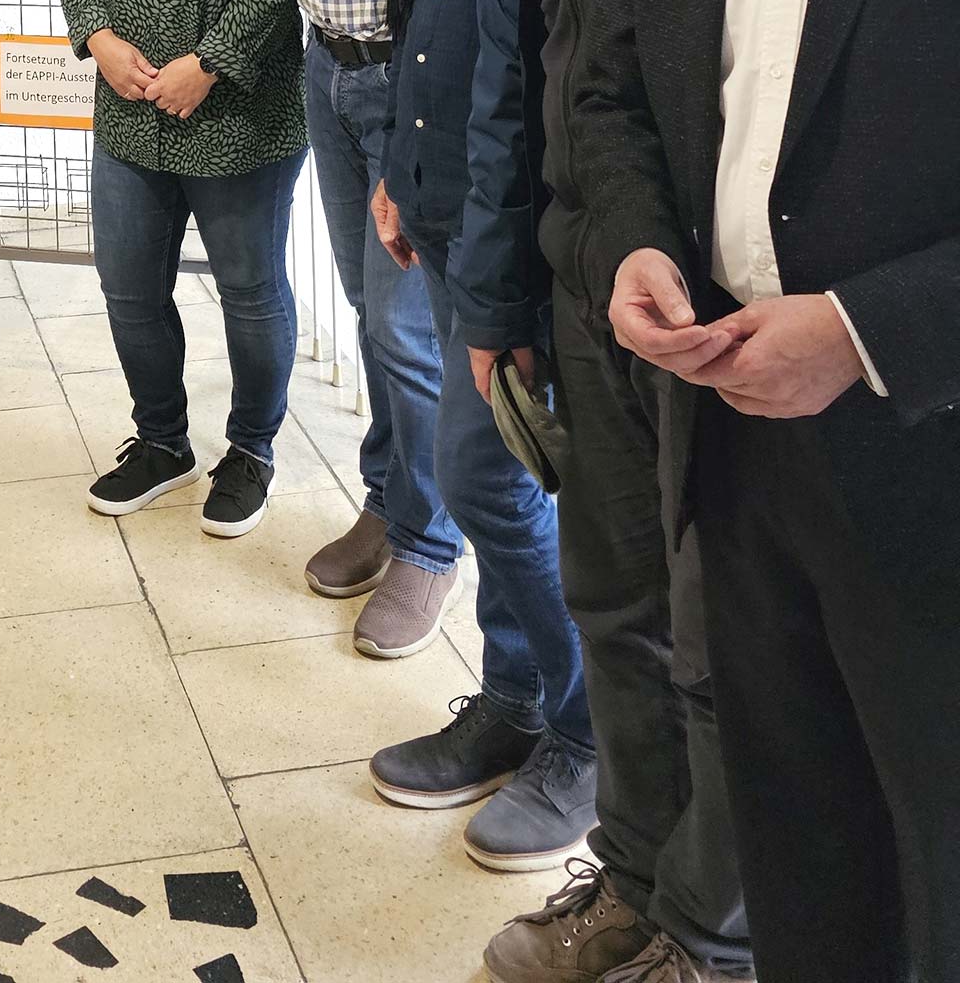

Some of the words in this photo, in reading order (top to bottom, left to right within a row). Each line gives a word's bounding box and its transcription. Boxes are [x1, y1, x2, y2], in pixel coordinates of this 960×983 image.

[6, 52, 66, 67] Fortsetzung
[6, 69, 23, 79] der
[26, 70, 95, 82] EAPPI-Ausste
[6, 90, 19, 100] im
[22, 91, 96, 105] Untergeschos
